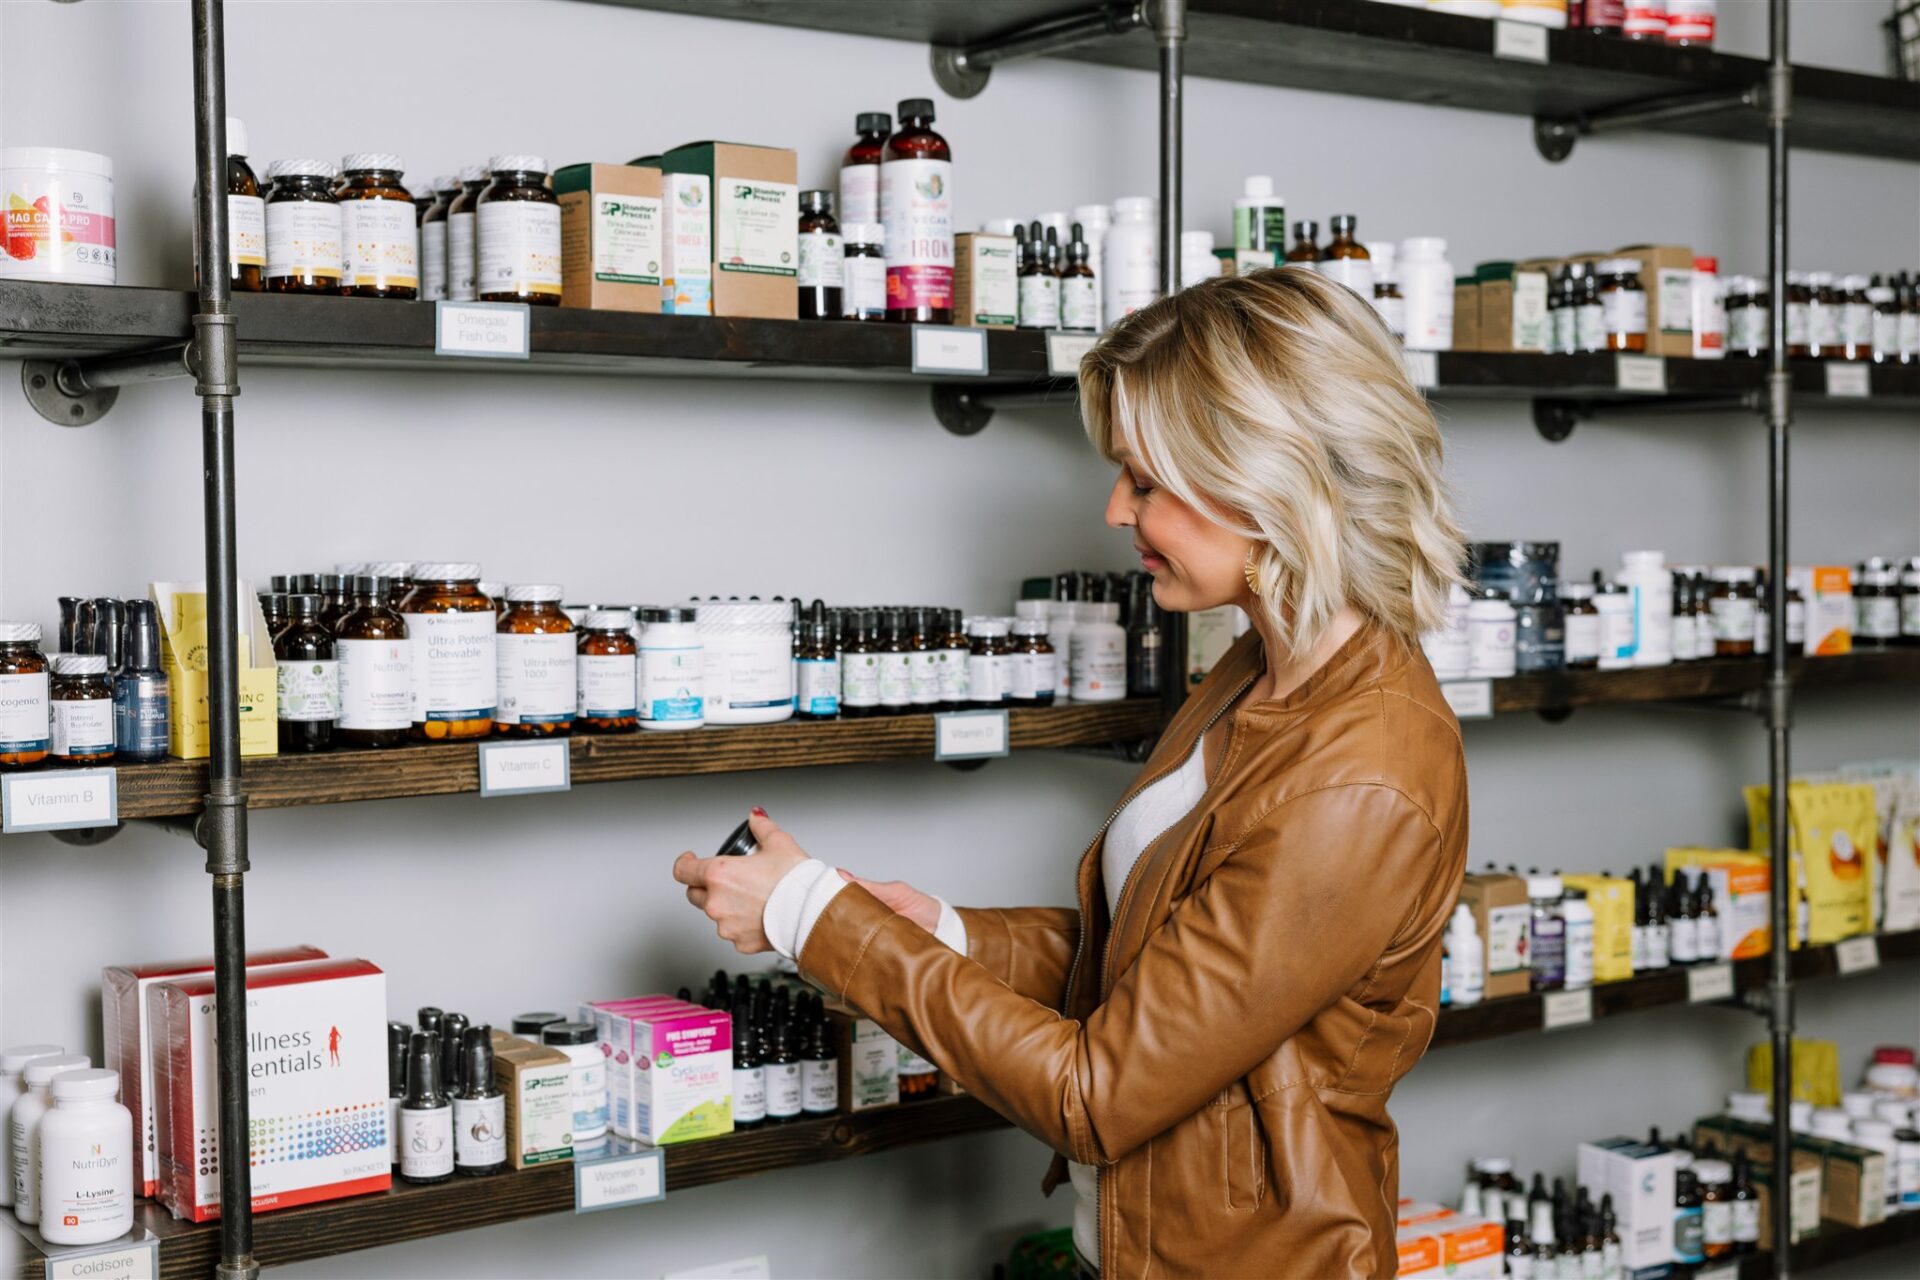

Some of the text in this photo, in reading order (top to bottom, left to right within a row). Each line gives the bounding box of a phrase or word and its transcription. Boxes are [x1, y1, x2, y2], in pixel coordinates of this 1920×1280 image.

[8, 213, 90, 225] MAG CAM PRO
[911, 239, 951, 258] IRON
[458, 330, 509, 343] Fish Oils
[428, 634, 456, 645] Ultra
[428, 648, 482, 659] Chewable
[524, 669, 548, 678] 1000
[0, 697, 39, 708] cogenics
[950, 726, 994, 740] Vitamin D
[498, 759, 553, 773] Vitamin C
[28, 790, 94, 806] Vitamin B
[251, 1030, 312, 1052] llness
[251, 1051, 322, 1078] entials
[72, 1157, 119, 1169] NutriDyn
[595, 1166, 646, 1181] Women's
[76, 1188, 115, 1199] L-Lysine
[603, 1182, 639, 1196] Health
[72, 1257, 134, 1276] Coldsore
